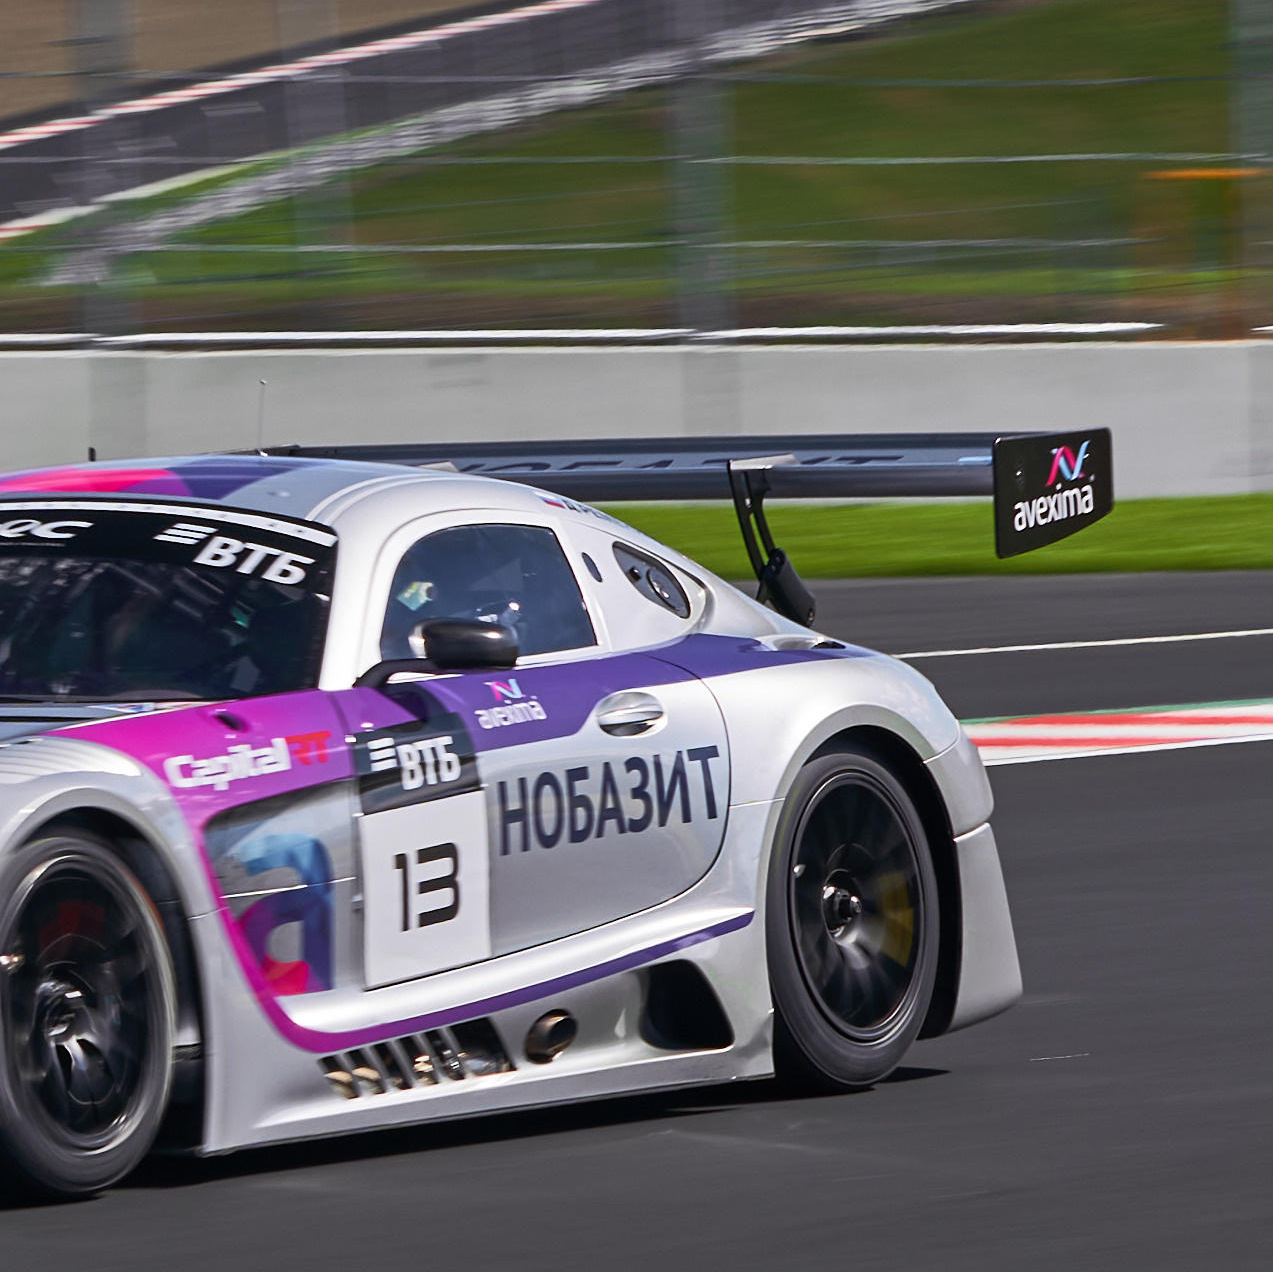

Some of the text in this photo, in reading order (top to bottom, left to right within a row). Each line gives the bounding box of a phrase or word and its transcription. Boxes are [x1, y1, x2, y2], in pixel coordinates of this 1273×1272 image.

[1014, 483, 1094, 532] avexima
[192, 535, 316, 585] ВТБ
[474, 699, 547, 729] avexima
[397, 735, 461, 790] ВТБ
[497, 745, 719, 856] НОБАЗИТ
[394, 842, 459, 931] 13
